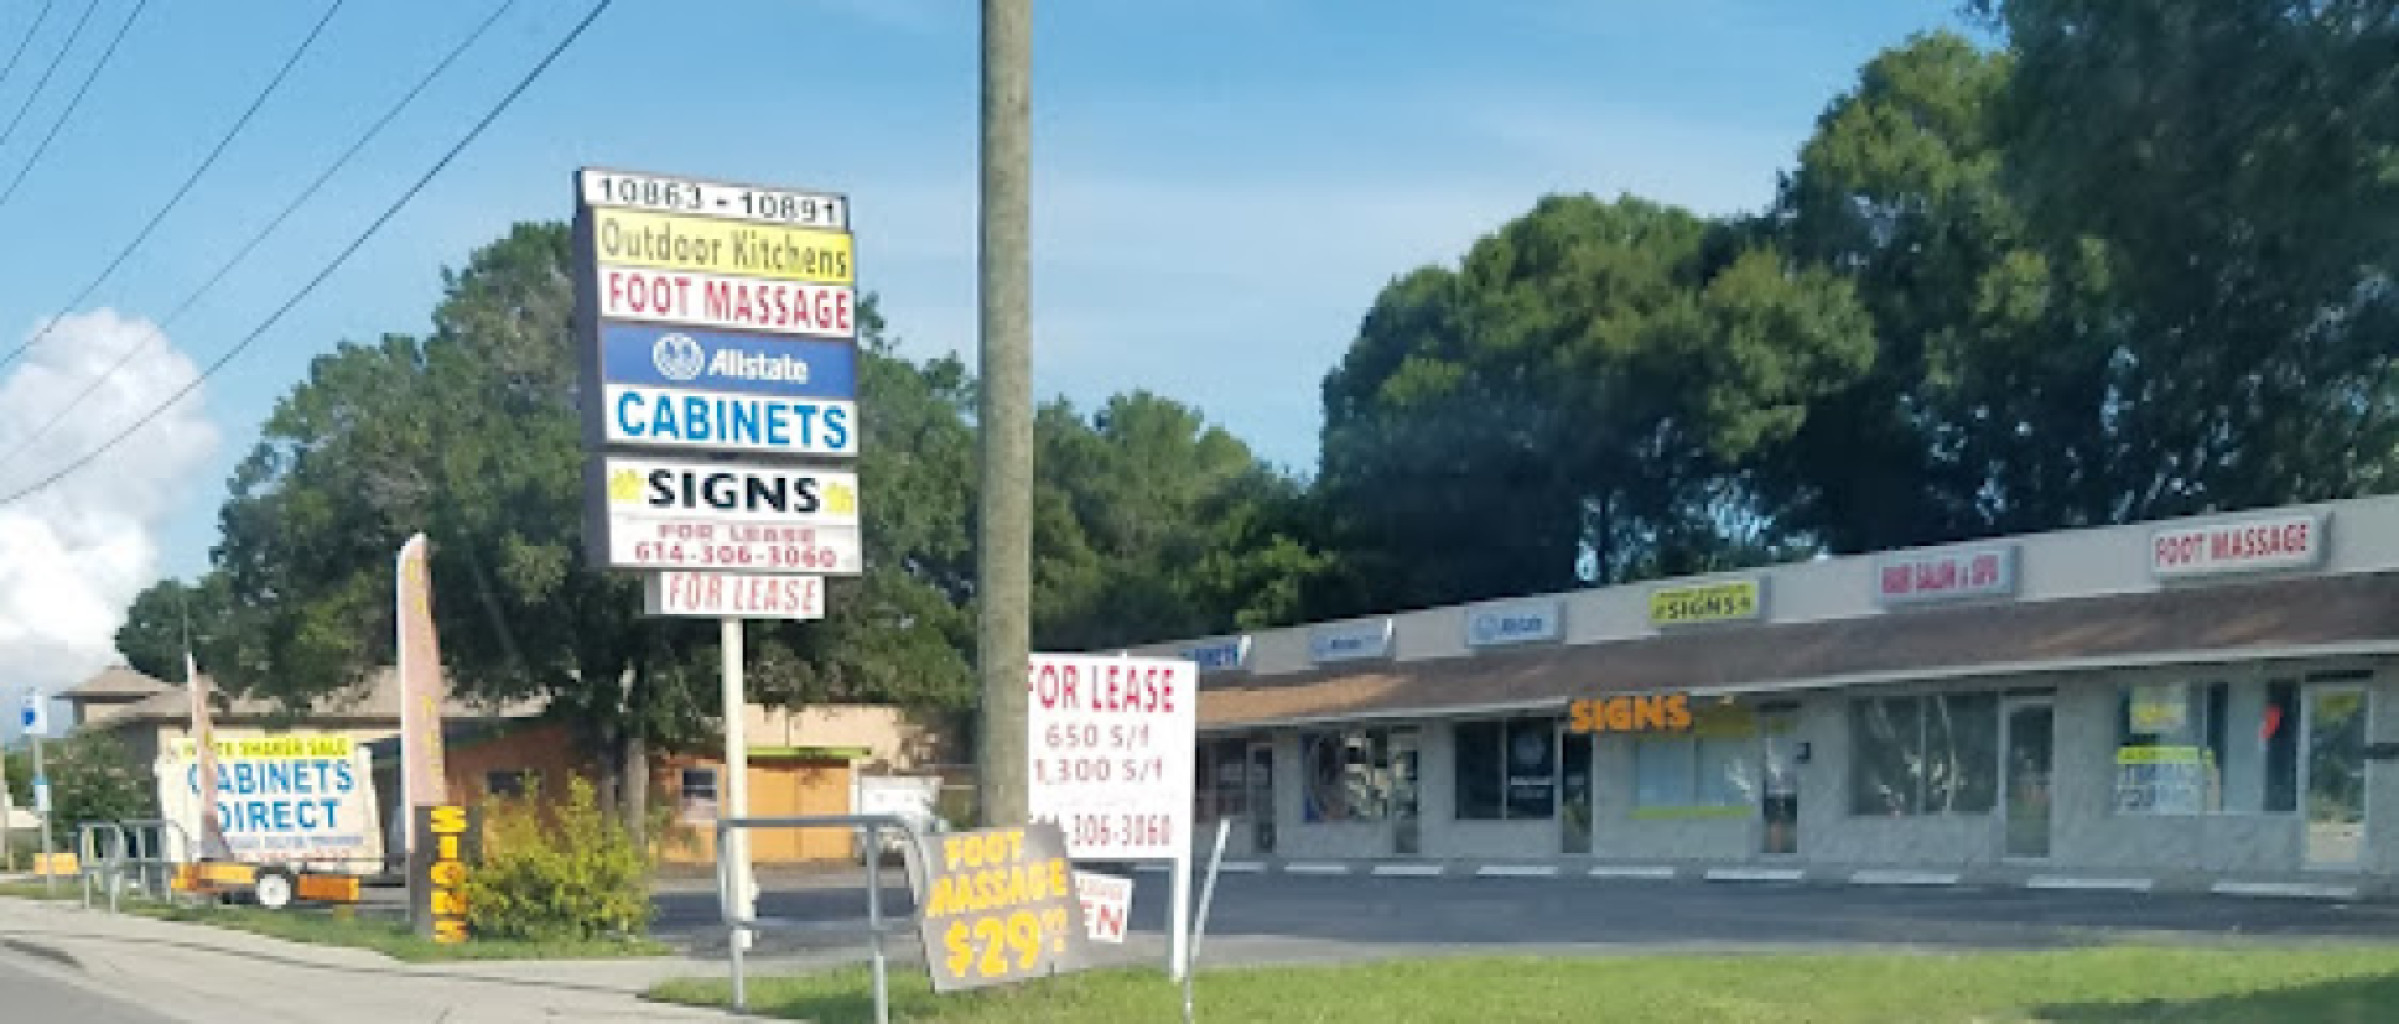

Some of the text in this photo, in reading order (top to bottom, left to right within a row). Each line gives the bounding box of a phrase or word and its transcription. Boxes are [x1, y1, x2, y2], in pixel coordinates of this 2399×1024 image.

[599, 177, 704, 211] 10863
[736, 190, 840, 222] 10891
[601, 217, 847, 278] Outdoor Kitchens
[609, 272, 851, 329] FOOT MASSAGE
[707, 348, 810, 385] Allstate
[617, 390, 848, 449] CABINETS
[648, 468, 822, 514] SIGNS
[634, 540, 838, 569] 614-306-3060
[658, 523, 817, 546] FOR LEASE
[2155, 522, 2309, 566] FOOT MASSAGE
[668, 571, 816, 613] FOR LEASE
[1667, 597, 1738, 621] SIGNS
[1091, 664, 1175, 714] LEASE
[1045, 723, 1098, 749] 650
[1569, 694, 1692, 734] SIGNS
[1034, 757, 1111, 785] 1,300
[942, 830, 1025, 872] FOOT
[429, 805, 469, 944] SIGNS
[926, 857, 1068, 919] MASSAGE
[944, 910, 1041, 978] $29
